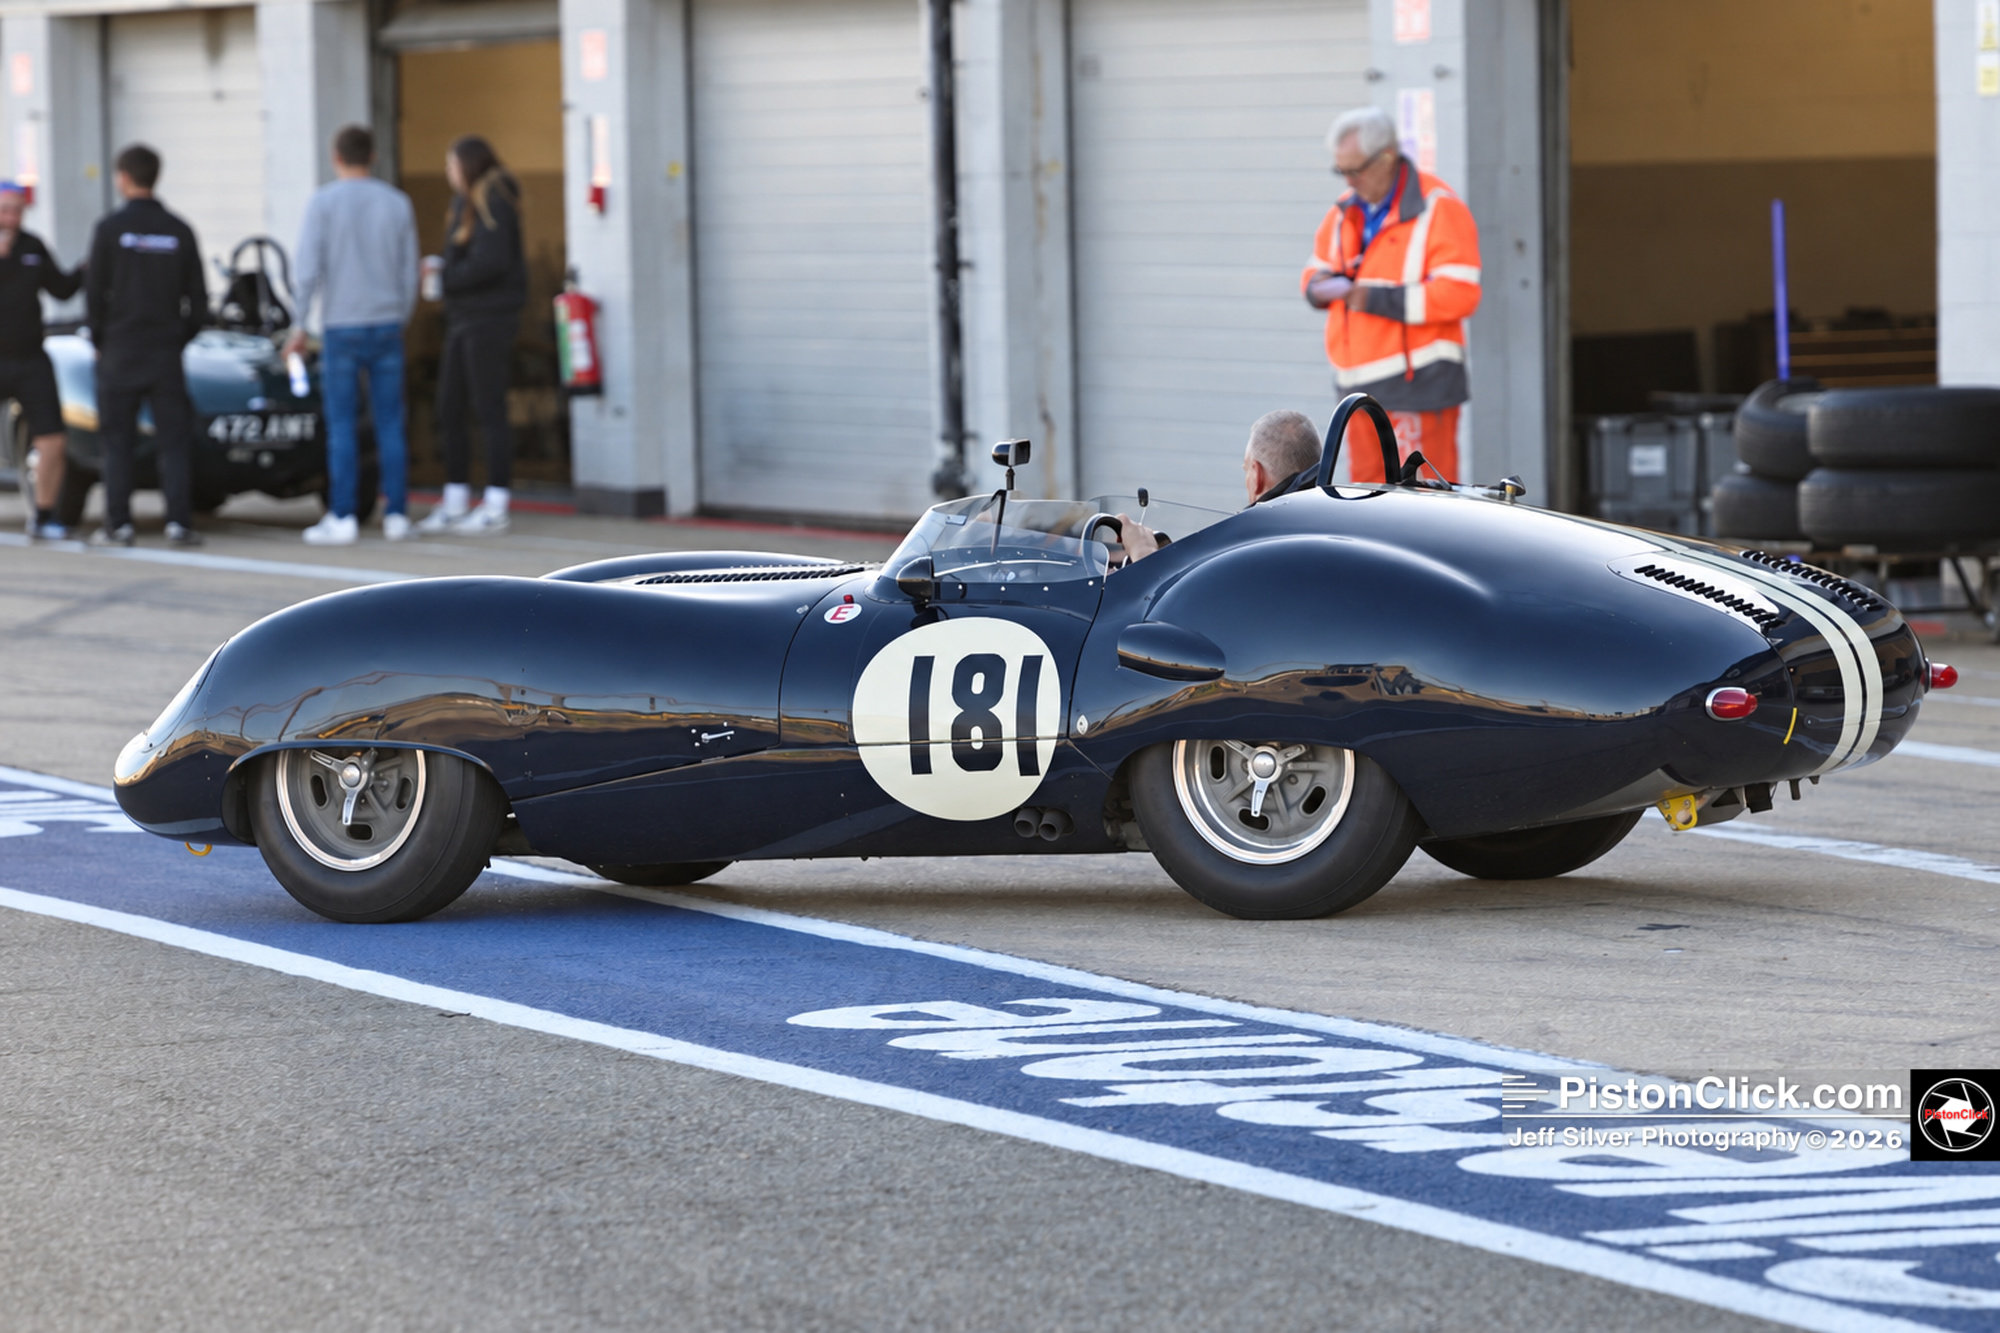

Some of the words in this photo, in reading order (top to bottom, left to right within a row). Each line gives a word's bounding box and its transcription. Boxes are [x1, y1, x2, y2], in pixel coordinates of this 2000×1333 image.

[207, 413, 262, 443] 472
[829, 605, 855, 621] E
[908, 652, 1045, 777] 181
